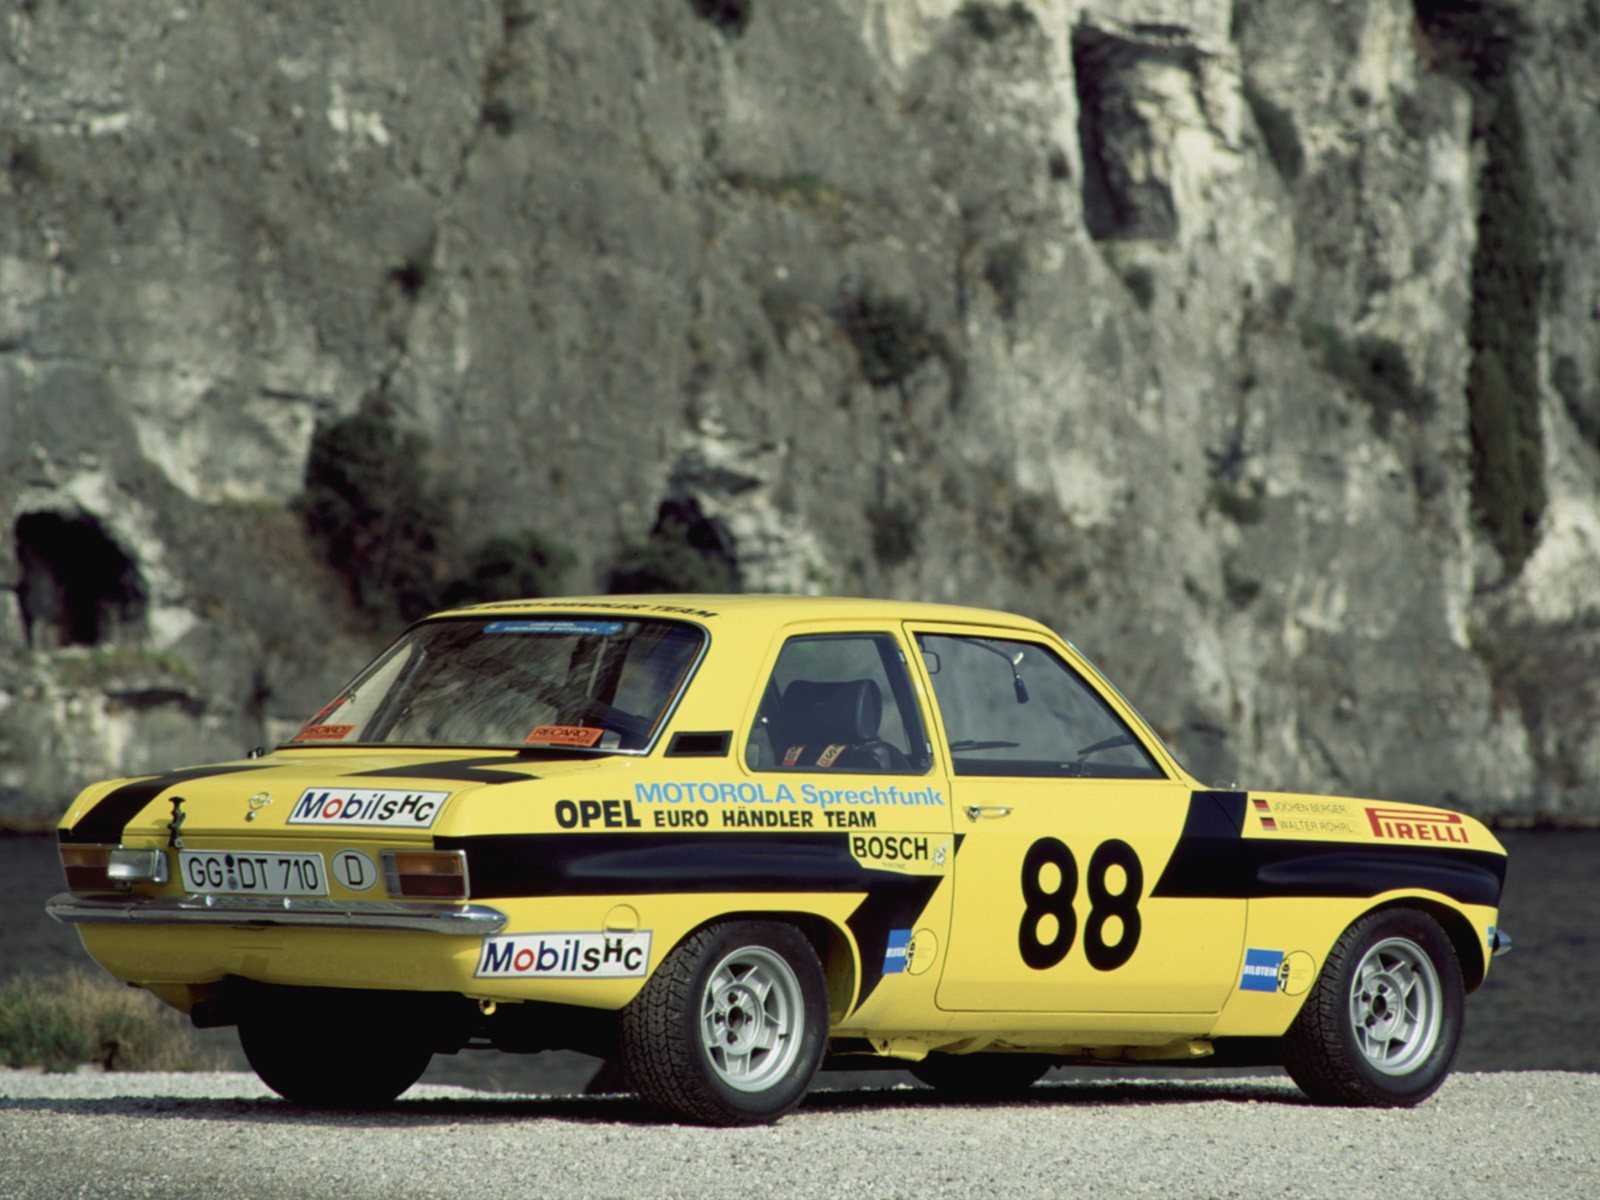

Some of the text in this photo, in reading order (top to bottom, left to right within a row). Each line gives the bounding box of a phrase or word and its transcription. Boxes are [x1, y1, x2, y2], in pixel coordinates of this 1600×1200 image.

[635, 782, 944, 809] MOTOROLA Sprechfunk
[1273, 802, 1347, 814] JOCHEN BERGER
[555, 800, 877, 828] OPEL EURO HÄNDLER TEAM
[1280, 820, 1318, 832] WALTER
[1364, 807, 1469, 843] PIRELLI
[853, 836, 929, 860] BOSCH
[278, 859, 319, 890] 710
[345, 855, 364, 886] D
[1018, 836, 1144, 972] 88
